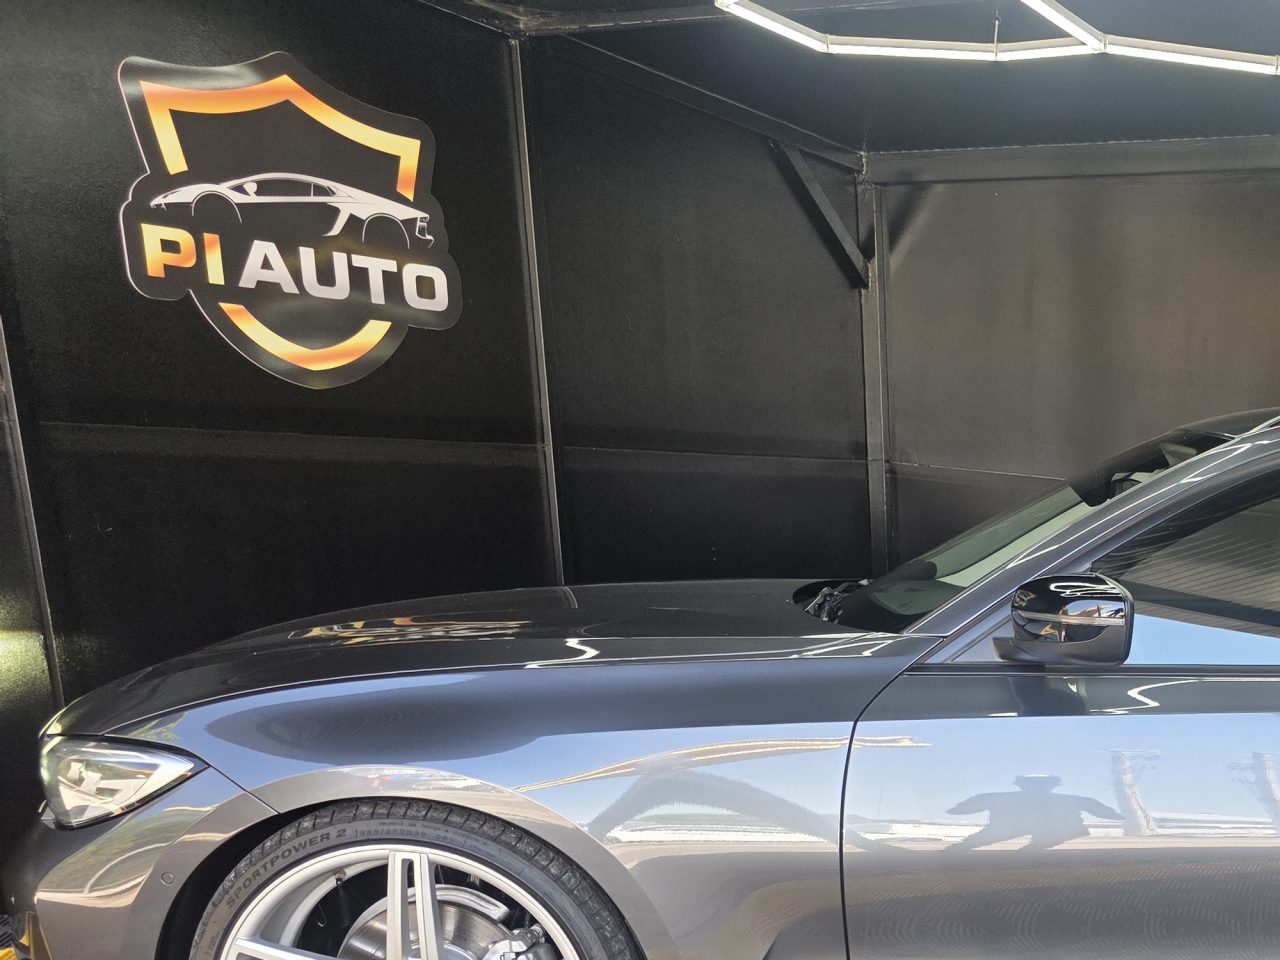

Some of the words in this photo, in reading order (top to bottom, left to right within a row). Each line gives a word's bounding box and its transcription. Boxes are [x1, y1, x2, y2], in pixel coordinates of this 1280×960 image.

[140, 223, 225, 286] PI
[238, 240, 449, 312] AUTO
[225, 832, 331, 909] SPORTPOWER
[335, 828, 347, 839] 2
